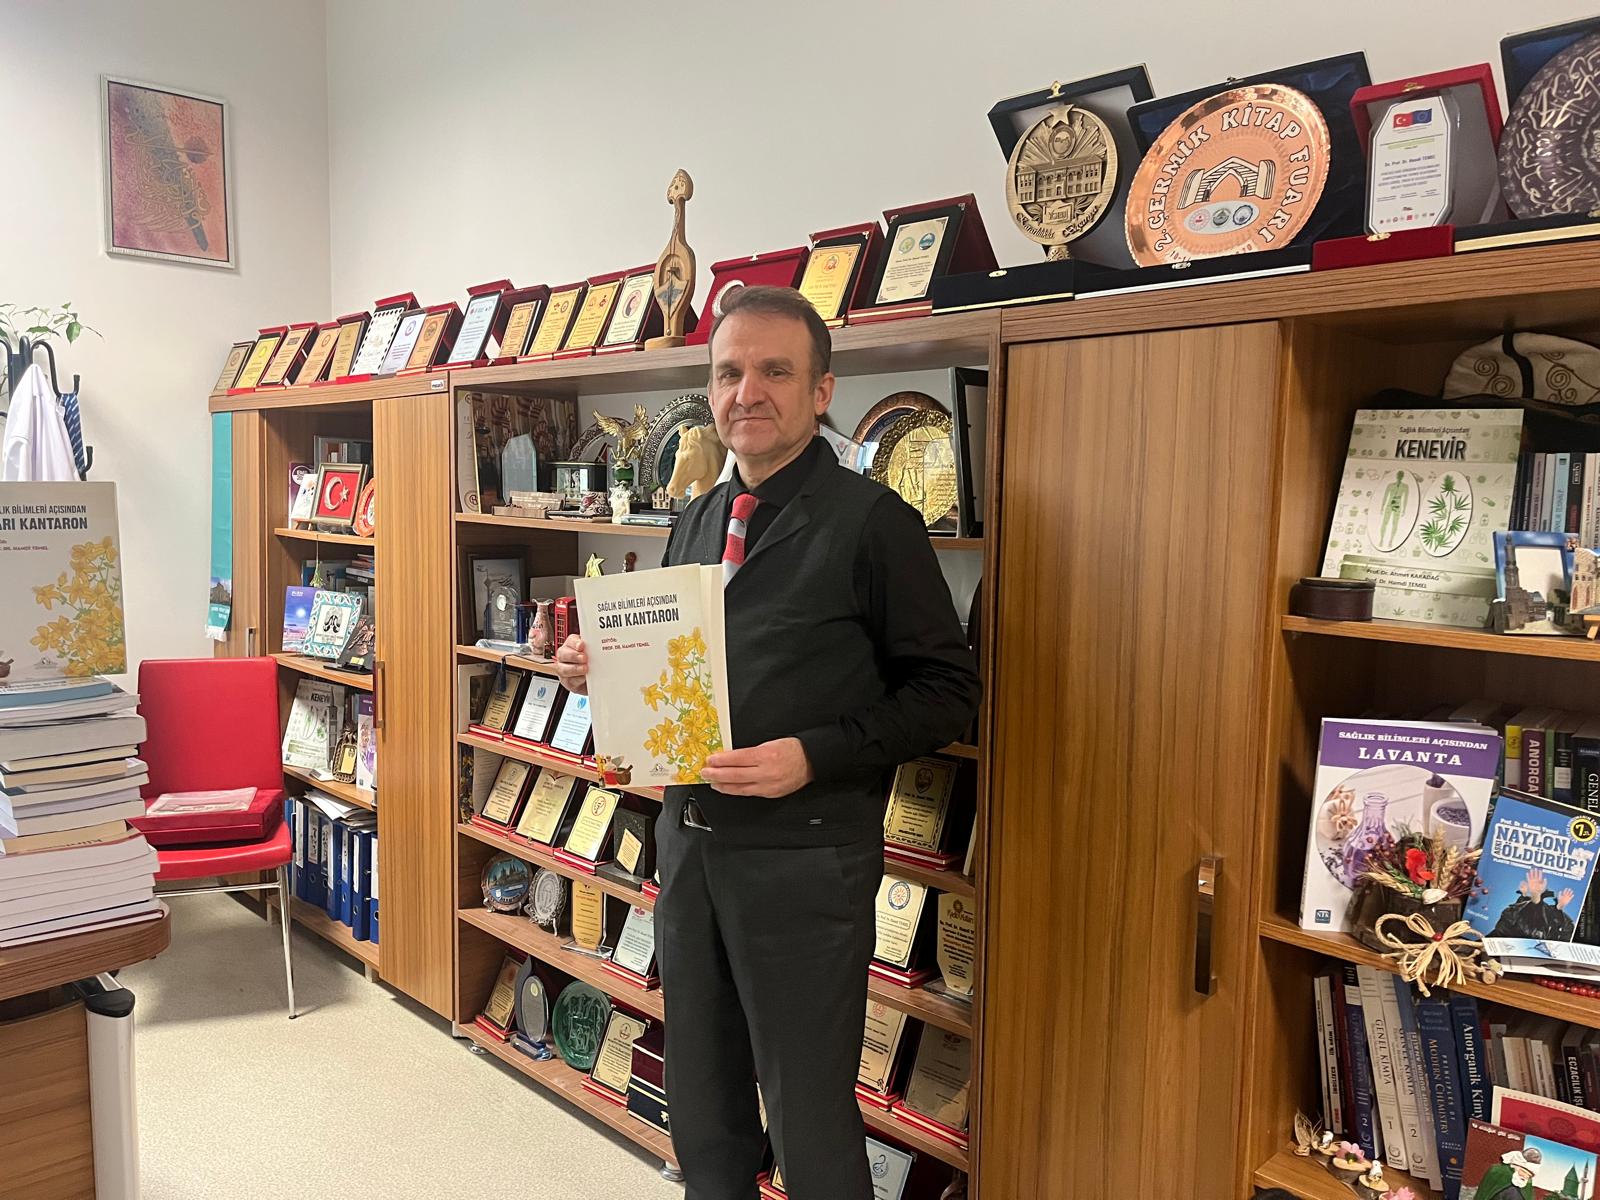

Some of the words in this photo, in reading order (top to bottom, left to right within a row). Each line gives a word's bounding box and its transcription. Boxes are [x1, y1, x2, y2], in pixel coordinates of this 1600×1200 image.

[1221, 102, 1301, 140] KİTAP
[1258, 144, 1311, 243] FUARI
[1395, 436, 1467, 460] KENEVİR
[11, 504, 47, 515] BİLİMLERİ
[48, 505, 87, 517] AÇISINDAN
[20, 517, 88, 531] KANTARON
[598, 601, 618, 612] SAĞLIK
[617, 596, 646, 610] BİLİMLERİ
[646, 593, 678, 608] AÇISINDAN
[598, 614, 623, 629] SARI
[624, 607, 680, 627] KANTARON
[1338, 731, 1376, 741] SAĞLIK
[1377, 733, 1430, 744] BİLİMLERİ
[1432, 738, 1488, 750] AÇISINDAN
[1358, 747, 1462, 766] LAVANTA
[1588, 773, 1599, 811] GENEL
[1496, 826, 1568, 854] NAYLON
[1375, 1019, 1387, 1050] GENEL
[1462, 1023, 1482, 1085] Anorganik
[1380, 1053, 1392, 1085] KİMYA
[1567, 1056, 1582, 1095] ECZACILIK
[1428, 1039, 1442, 1080] MODERN
[1435, 1083, 1449, 1135] CHEMISTRY
[1387, 1120, 1393, 1130] 1
[1410, 1128, 1418, 1138] 2
